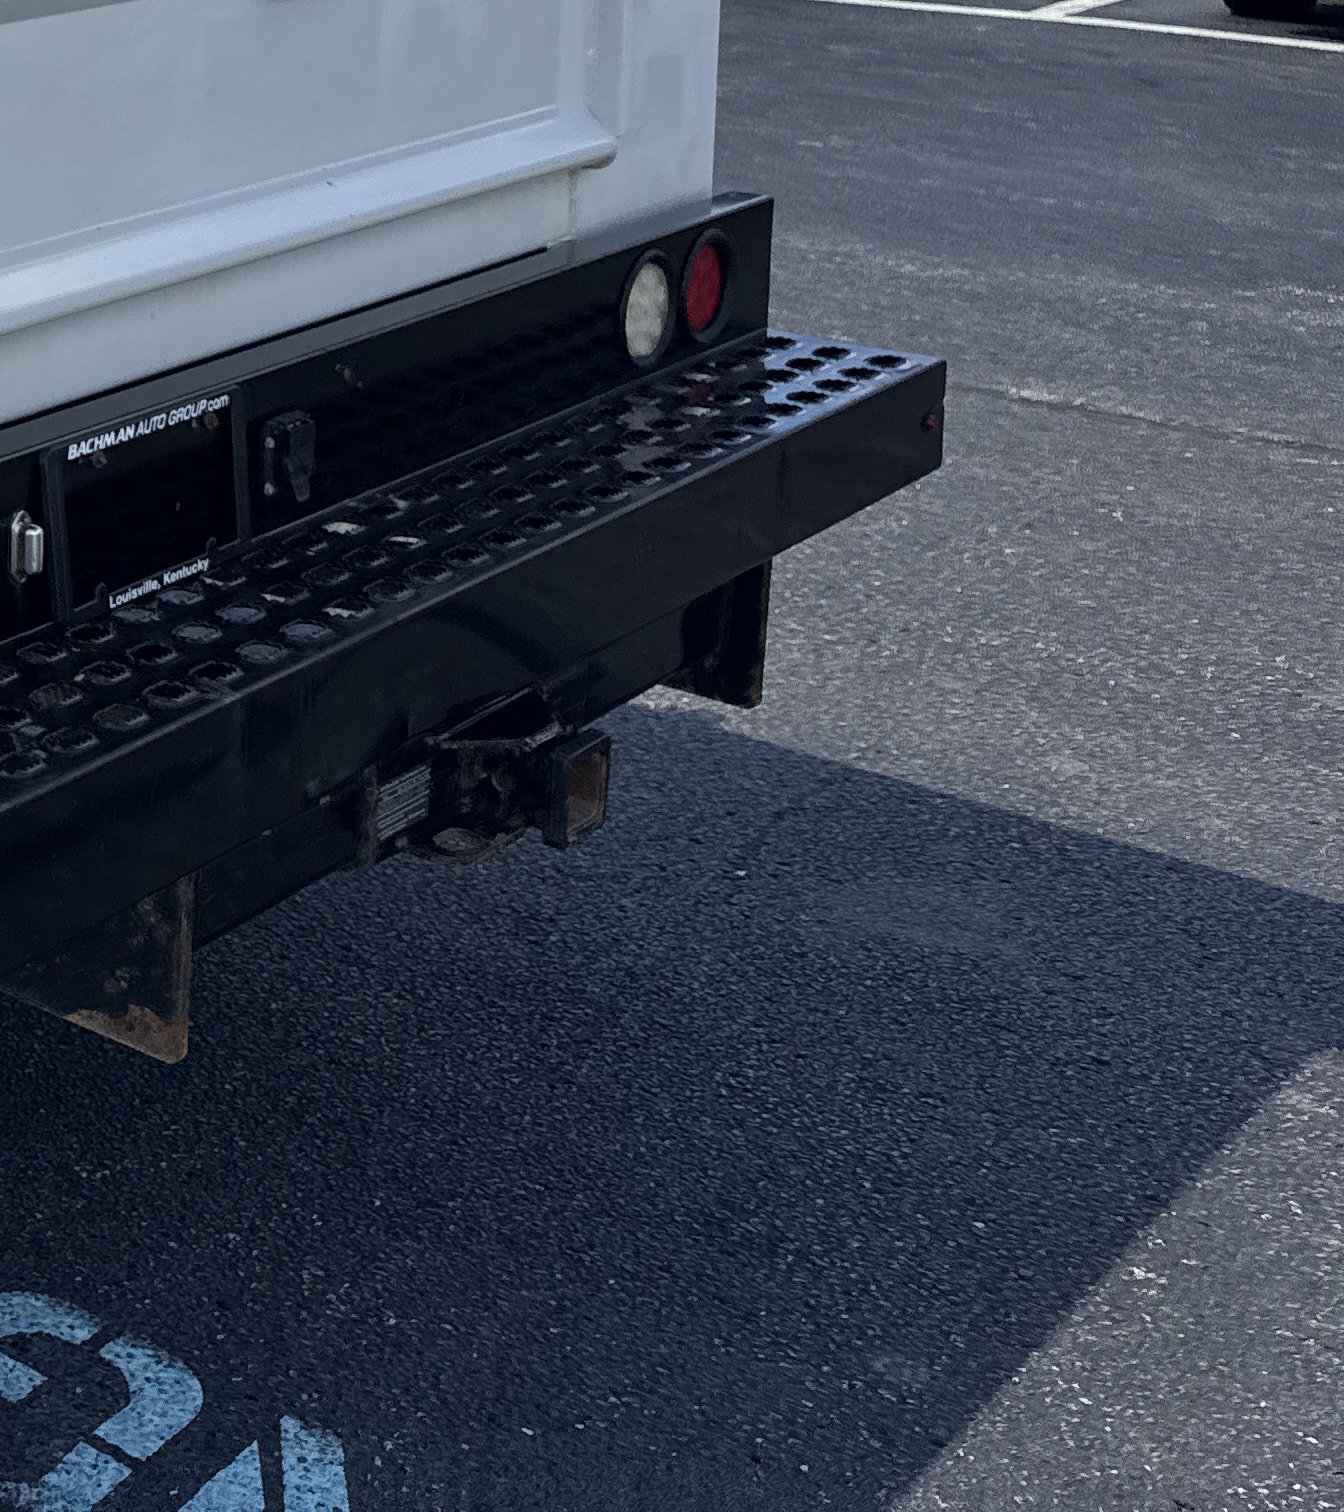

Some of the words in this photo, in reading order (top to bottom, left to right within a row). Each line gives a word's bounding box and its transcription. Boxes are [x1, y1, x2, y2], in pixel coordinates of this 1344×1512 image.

[68, 423, 135, 460] BACHMAN
[135, 413, 167, 436] AUTO
[109, 579, 161, 609] Louisville,
[163, 558, 209, 585] Kentucky
